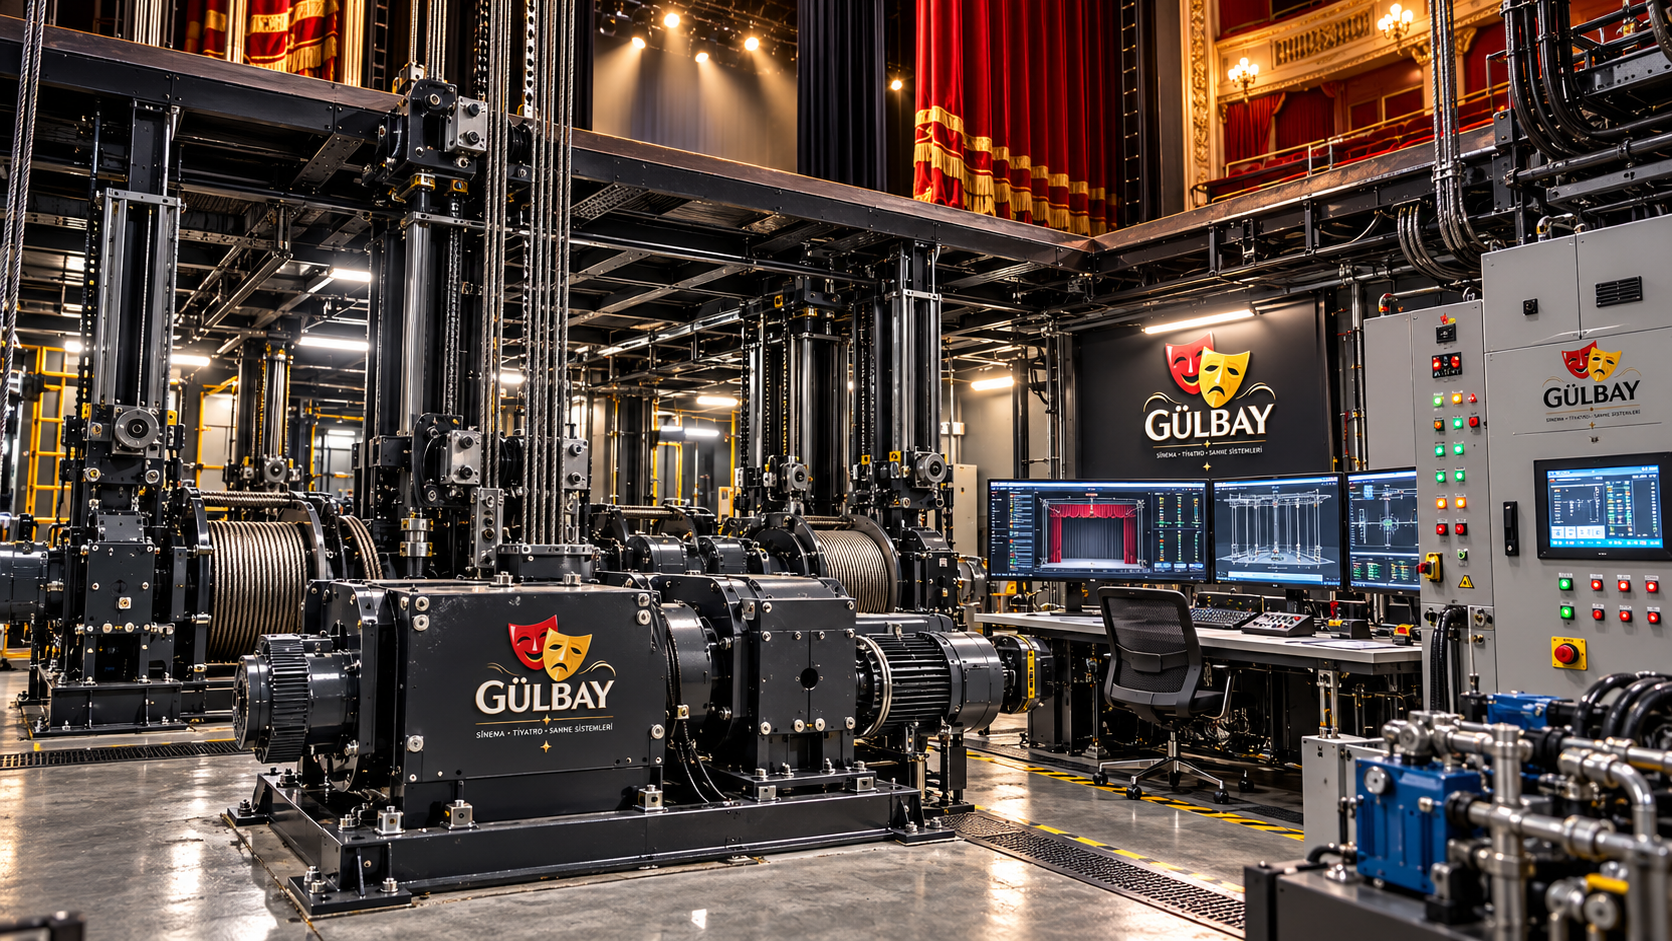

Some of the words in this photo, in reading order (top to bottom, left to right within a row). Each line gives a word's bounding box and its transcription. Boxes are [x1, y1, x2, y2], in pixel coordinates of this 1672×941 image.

[1543, 380, 1641, 408] GÜLBAY
[1144, 404, 1275, 441] GÜLBAY
[475, 677, 615, 715] GÜLBAY
[476, 729, 505, 739] SİNEMA
[512, 727, 543, 736] TİYATRO
